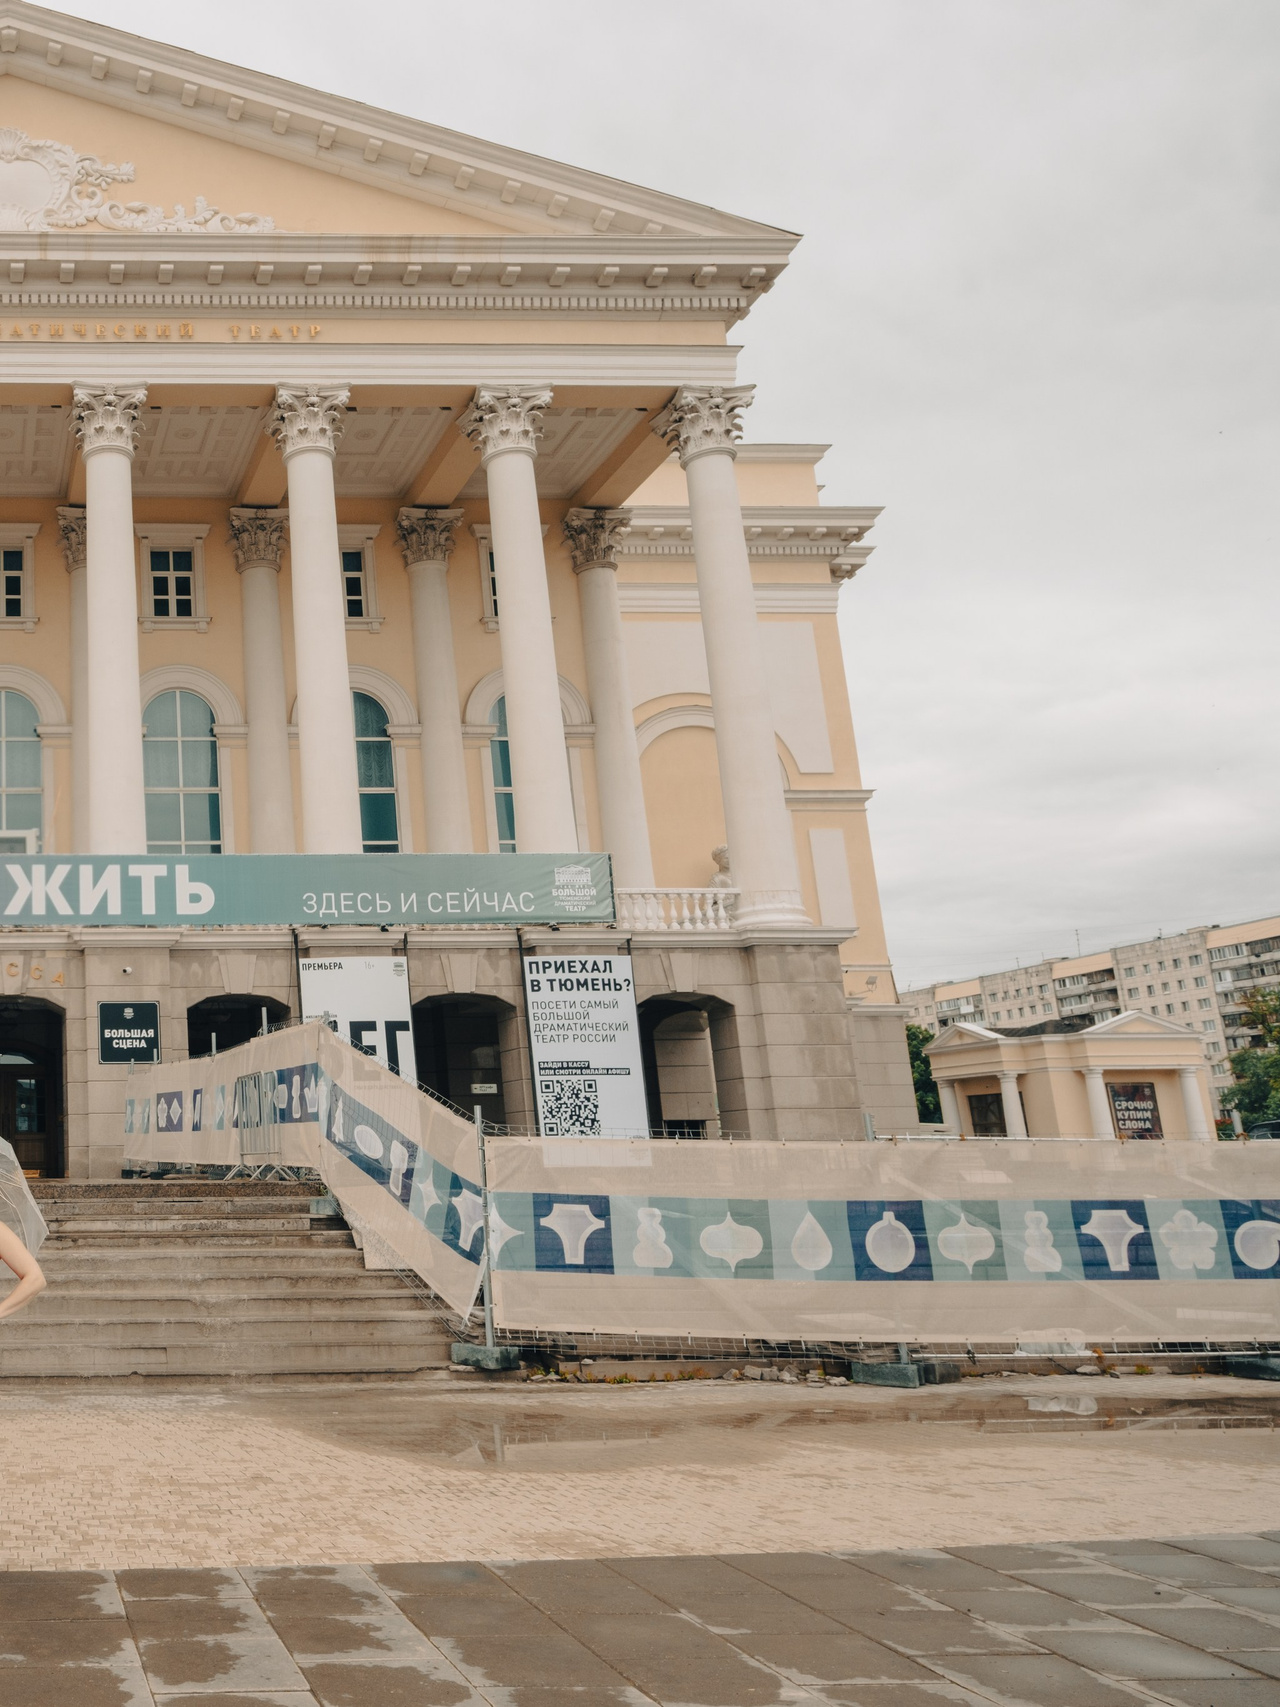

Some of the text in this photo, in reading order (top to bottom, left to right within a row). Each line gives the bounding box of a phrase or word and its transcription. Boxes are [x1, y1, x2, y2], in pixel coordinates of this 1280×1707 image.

[230, 324, 321, 338] ТЕАТР
[3, 864, 216, 916] ЖИТЬ
[552, 887, 596, 896] БОЛЬШОЙ
[303, 888, 535, 918] ЗДЕСЬ И СЕЙЧАС
[302, 962, 344, 971] ПРЕМЬЕРА
[528, 960, 613, 975] ПРИЕХАЛ
[530, 978, 631, 992] В ТЮМЕНЬ?
[532, 998, 619, 1010] ПОСЕТИ САМЫЙ
[533, 1009, 590, 1021] БОЛЬШОЙ
[534, 1021, 629, 1034] ДРАМАТИЧЕСКИЙ
[104, 1029, 155, 1038] БОЛЬШАЯ
[535, 1034, 617, 1043] ТЕАТР РОССИИ
[113, 1039, 147, 1050] СЦЕНА
[1115, 1101, 1154, 1110] СРОЧНО
[1116, 1110, 1152, 1119] КУПИМ
[1118, 1120, 1153, 1129] СЛОНА
